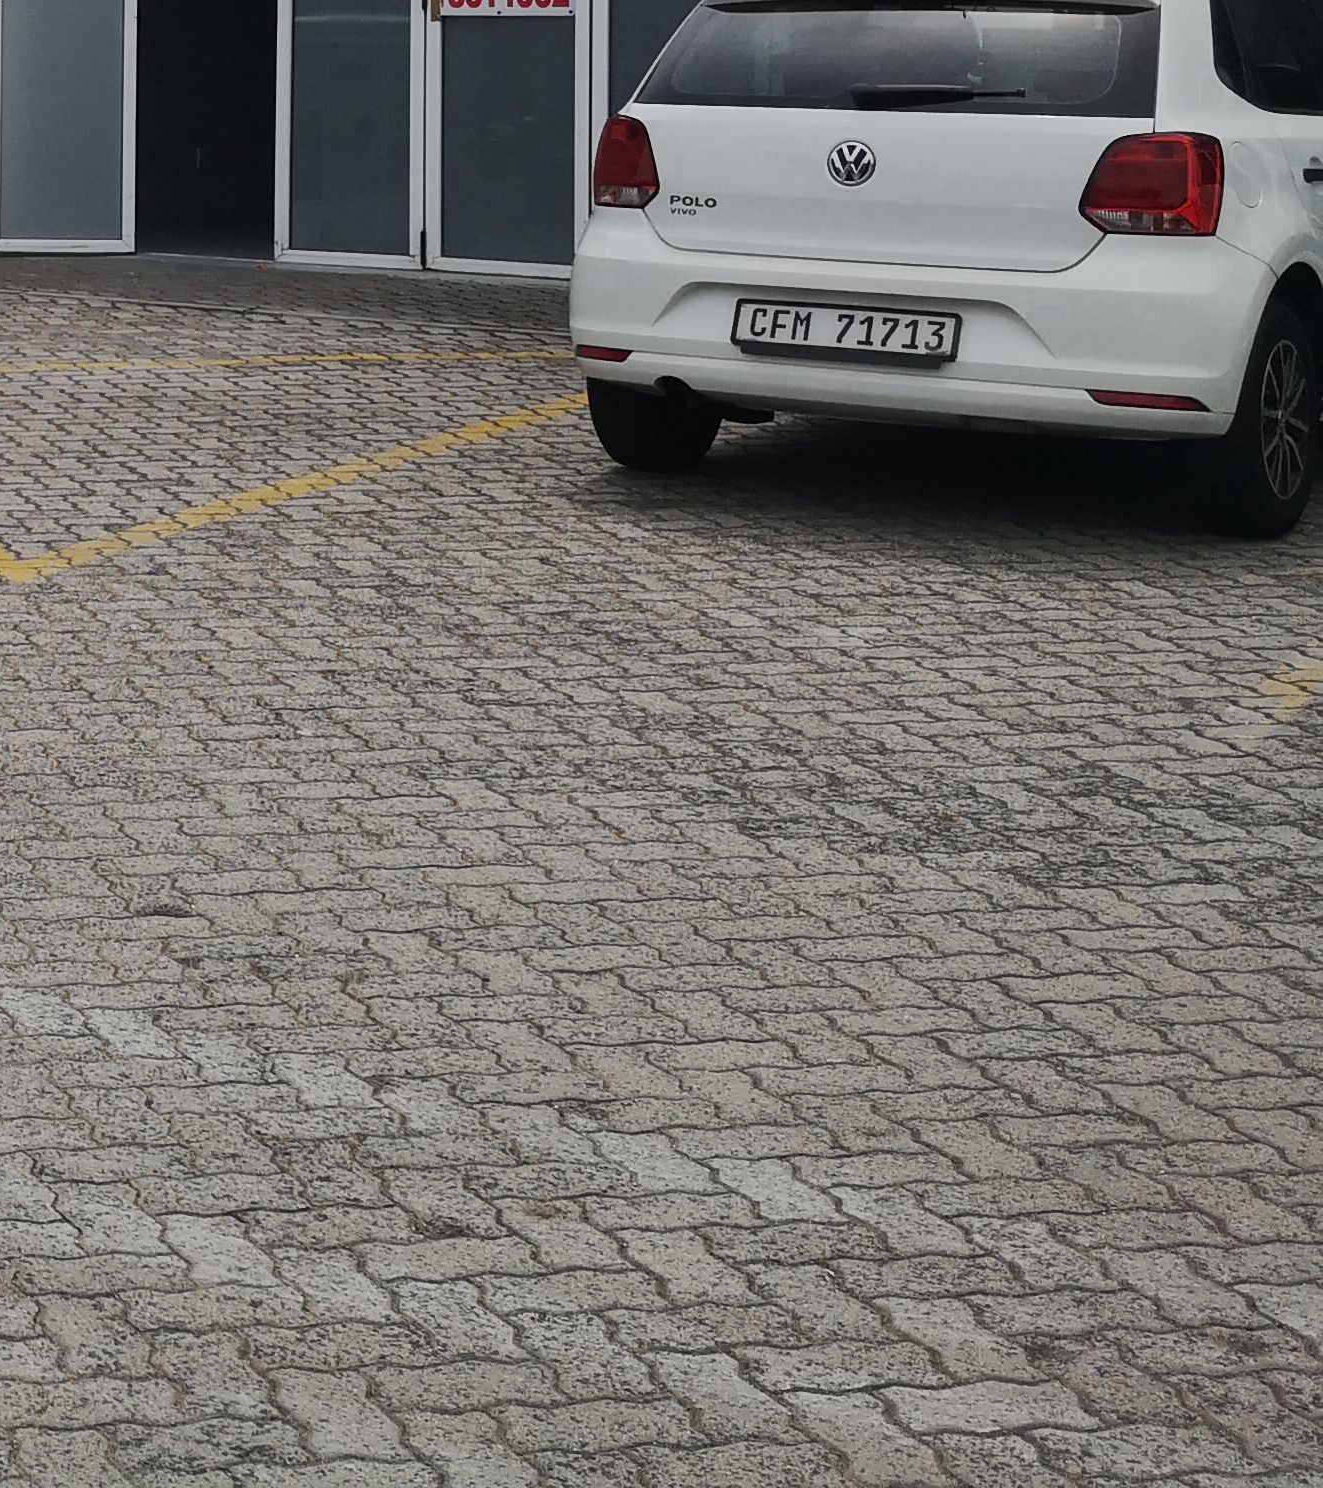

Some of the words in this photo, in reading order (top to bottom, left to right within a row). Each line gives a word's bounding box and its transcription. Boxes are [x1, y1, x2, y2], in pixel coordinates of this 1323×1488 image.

[669, 194, 717, 209] POLO
[670, 208, 697, 216] VIVO
[750, 307, 813, 342] CFM
[836, 313, 947, 352] 71713
